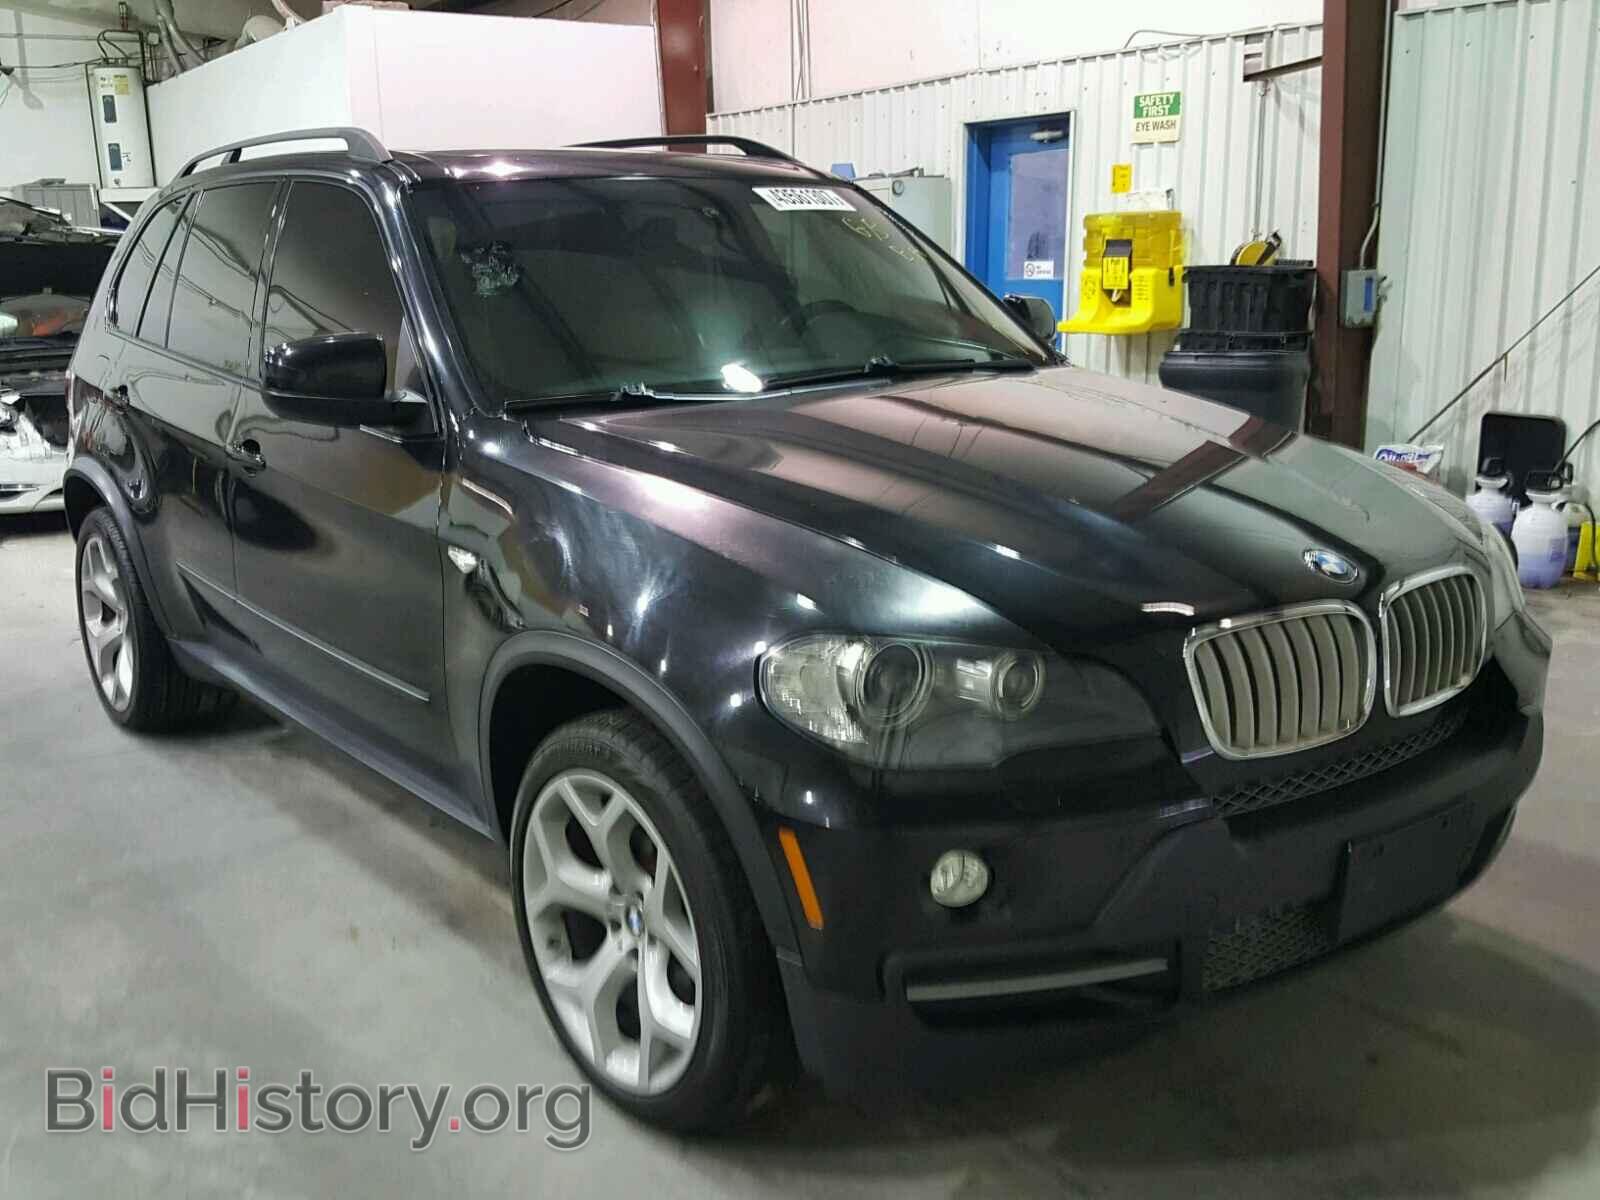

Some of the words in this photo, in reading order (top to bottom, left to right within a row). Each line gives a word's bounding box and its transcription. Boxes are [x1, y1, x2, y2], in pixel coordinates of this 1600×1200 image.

[1139, 94, 1174, 107] SAFETY
[1143, 107, 1169, 117] FIRST
[1136, 122, 1150, 132] EYE
[1152, 120, 1176, 131] WASH
